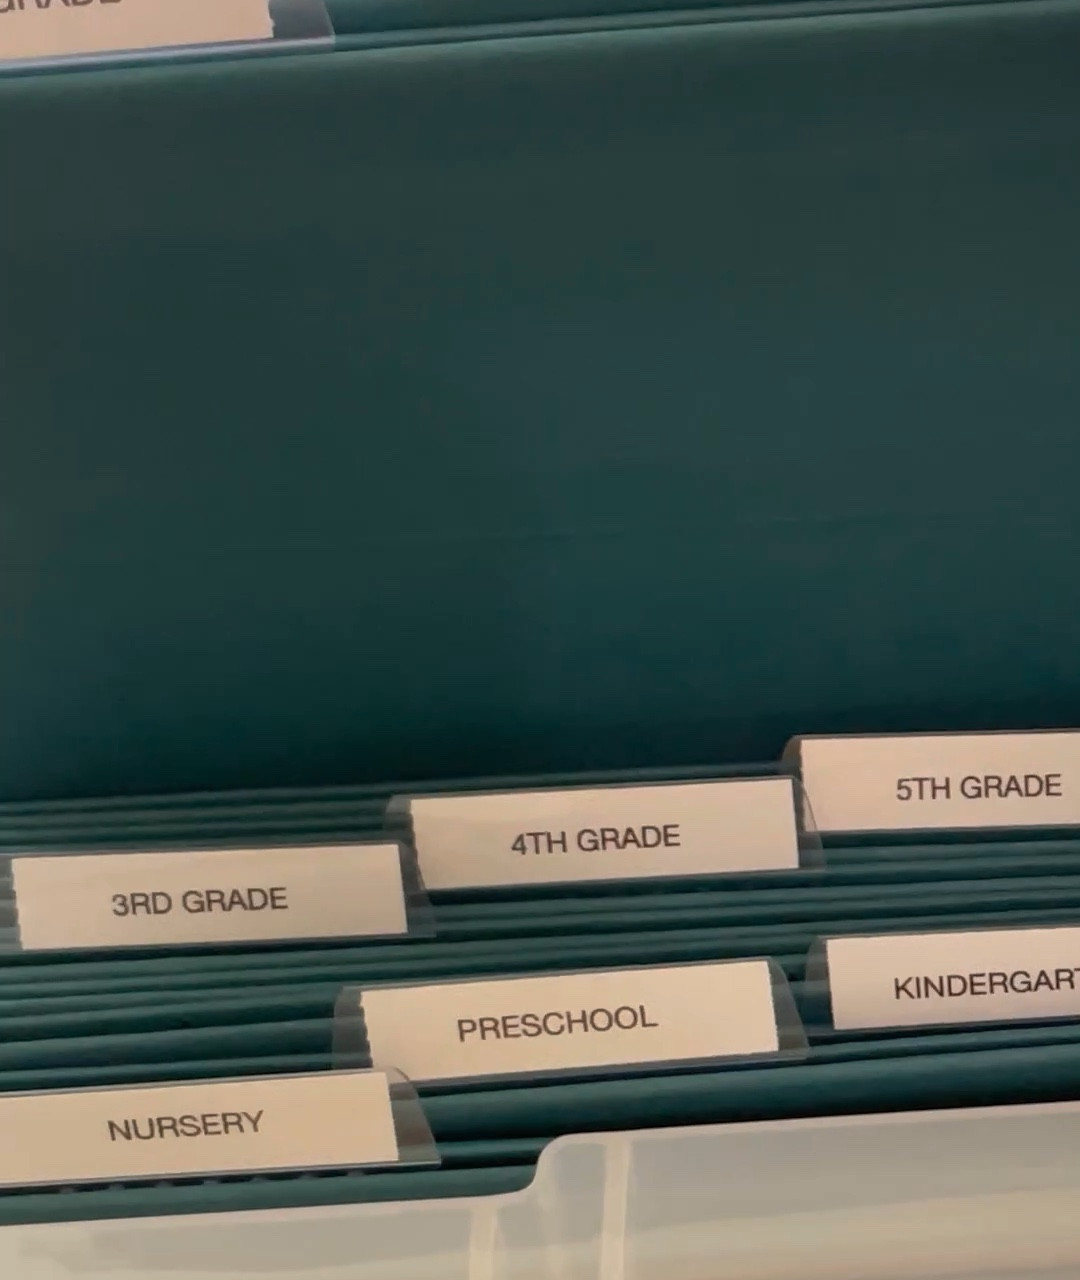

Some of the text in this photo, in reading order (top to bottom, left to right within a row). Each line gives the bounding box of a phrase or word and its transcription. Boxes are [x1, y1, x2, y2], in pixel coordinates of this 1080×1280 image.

[896, 773, 1062, 801] 5TH GRADE
[511, 824, 681, 856] 4TH GRADE
[112, 886, 289, 917] 3RD GRADE
[457, 1005, 658, 1043] PRESCHOOL
[107, 1110, 263, 1142] NURSERY
